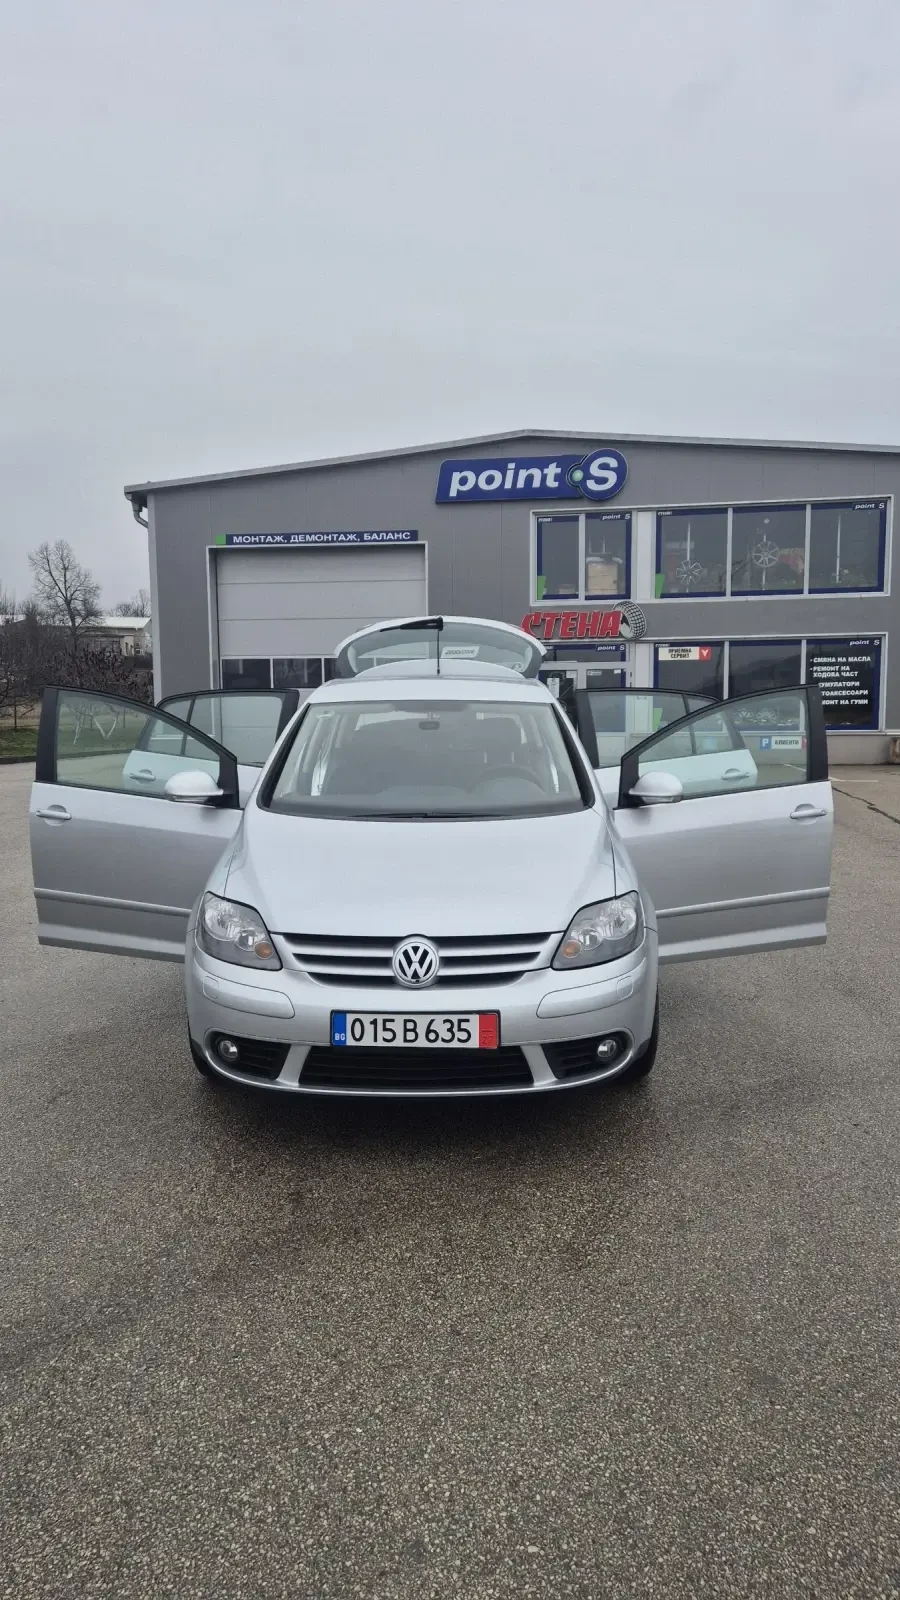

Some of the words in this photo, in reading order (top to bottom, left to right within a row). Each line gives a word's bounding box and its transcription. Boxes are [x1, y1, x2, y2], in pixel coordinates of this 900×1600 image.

[449, 462, 561, 497] point
[586, 456, 619, 491] S
[233, 535, 288, 543] МОНТАЖ,
[290, 533, 360, 543] ДЕМОНТАЖ,
[363, 532, 411, 541] БАЛАНС
[521, 610, 622, 639] СТЕНА
[334, 1032, 346, 1041] BG
